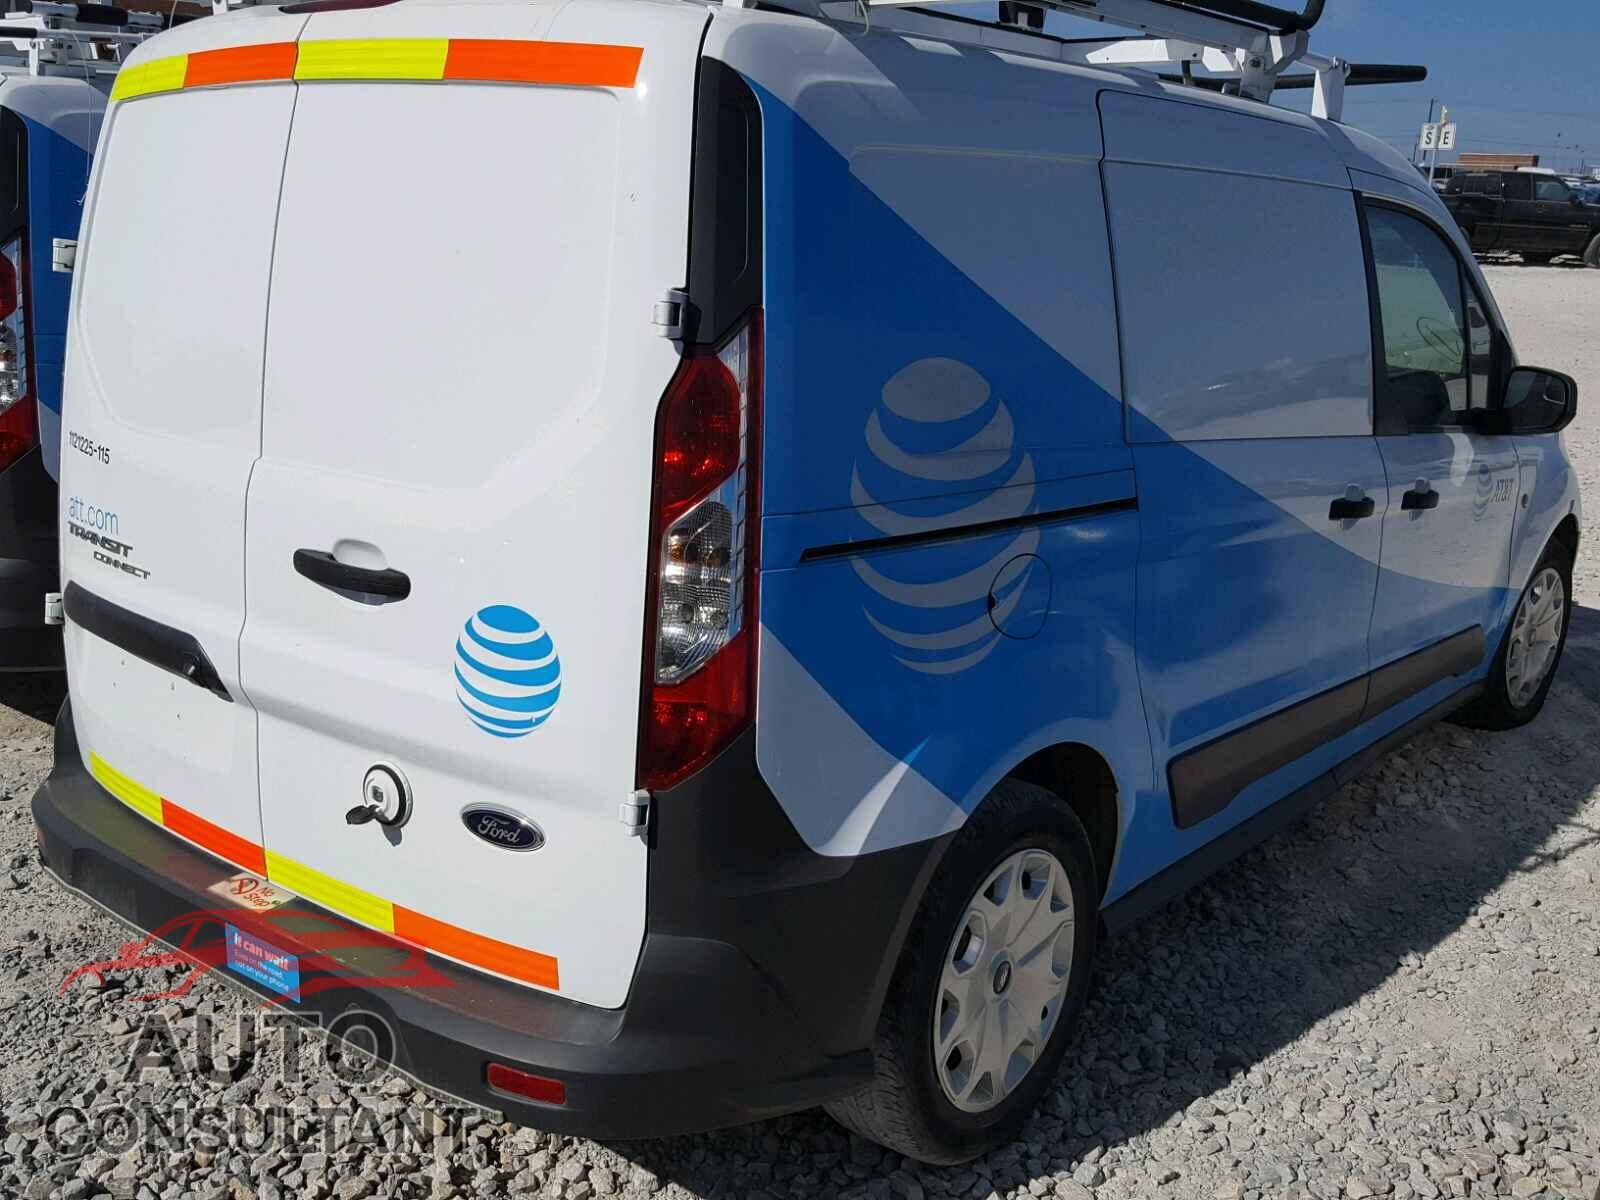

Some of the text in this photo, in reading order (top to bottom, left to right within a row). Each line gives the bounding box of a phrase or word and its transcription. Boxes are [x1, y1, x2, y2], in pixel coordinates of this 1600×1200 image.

[68, 496, 119, 536] att.com
[68, 520, 133, 557] TRANSIT
[93, 550, 151, 580] CONNECT
[478, 816, 520, 843] Ford
[243, 941, 263, 957] can
[264, 951, 289, 971] wait
